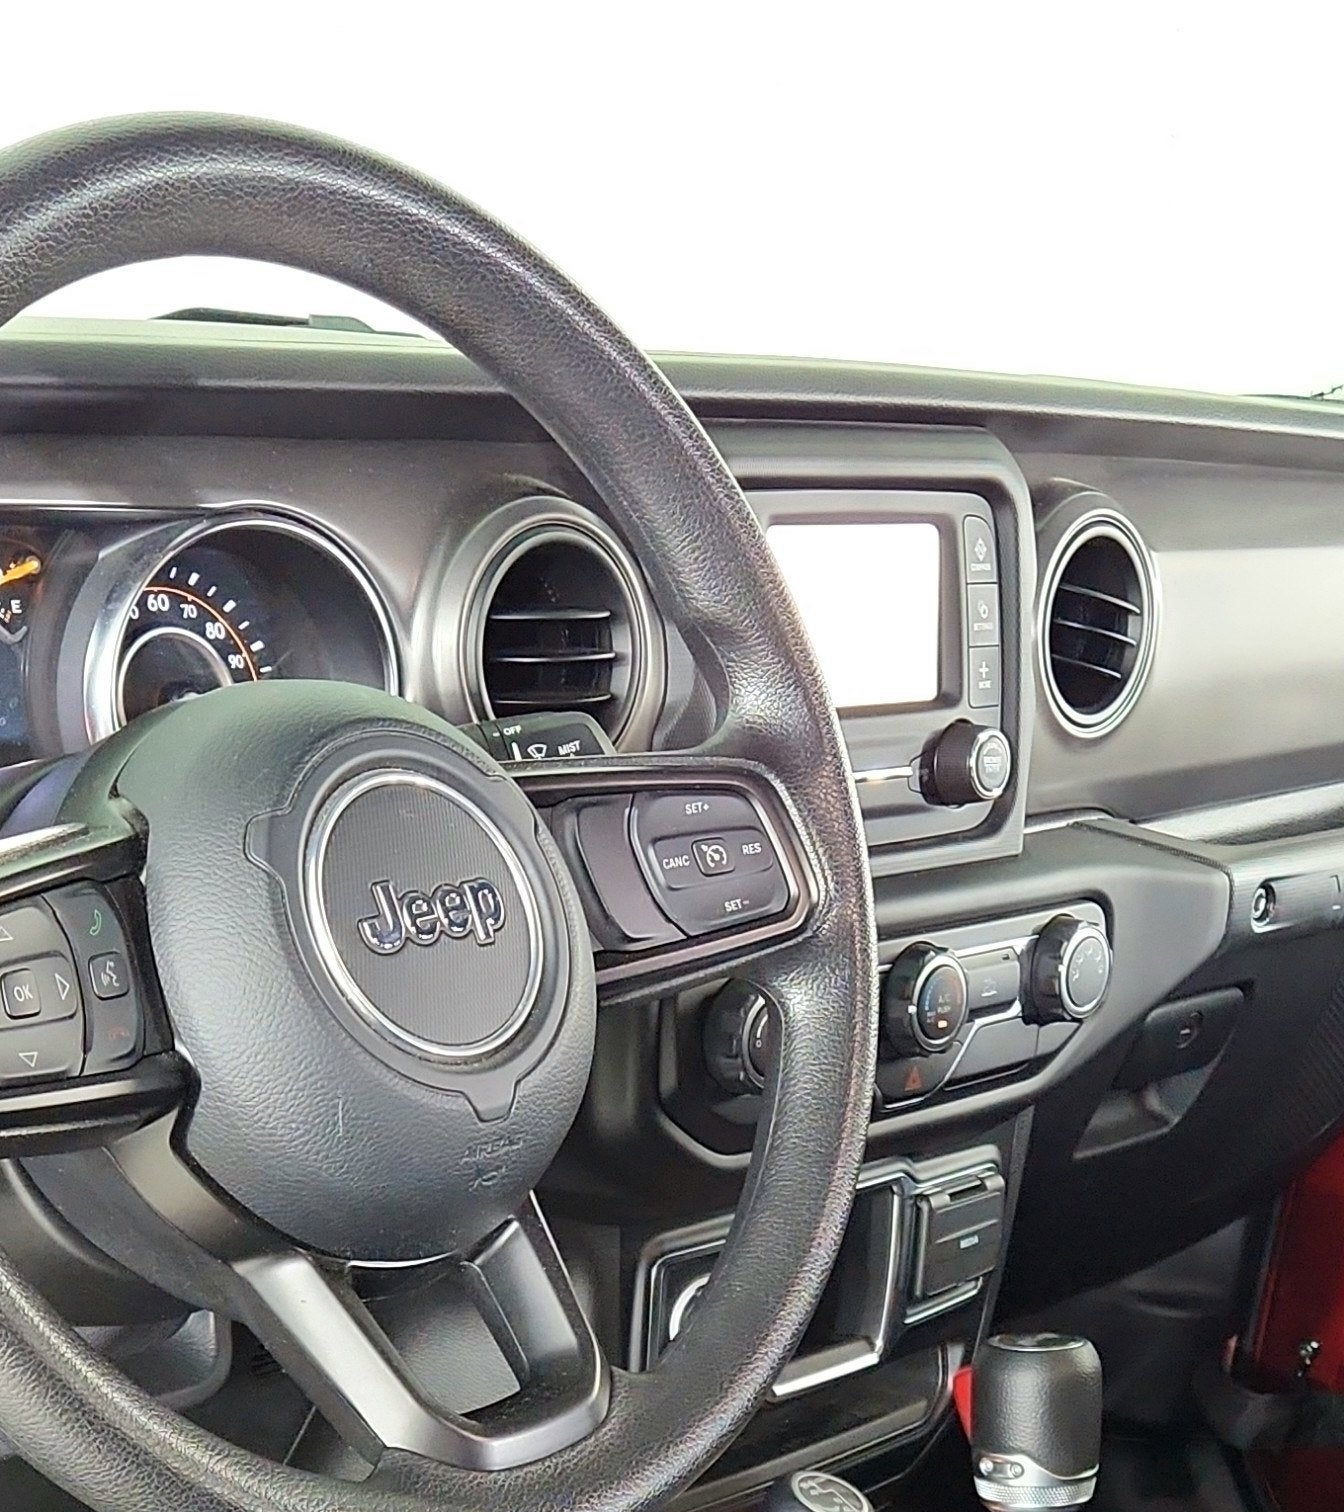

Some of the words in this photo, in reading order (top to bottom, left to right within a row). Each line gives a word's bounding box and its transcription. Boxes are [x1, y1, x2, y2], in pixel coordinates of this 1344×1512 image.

[10, 599, 22, 614] E
[146, 593, 170, 612] 60
[179, 603, 198, 619] 70
[205, 621, 226, 640] 80
[227, 653, 245, 669] 90
[503, 724, 523, 738] OFF
[557, 740, 582, 756] MIST
[685, 801, 710, 815] SET+
[741, 843, 762, 856] RES
[662, 854, 690, 870] CANC
[357, 876, 508, 955] Jeep
[13, 984, 34, 1002] OK
